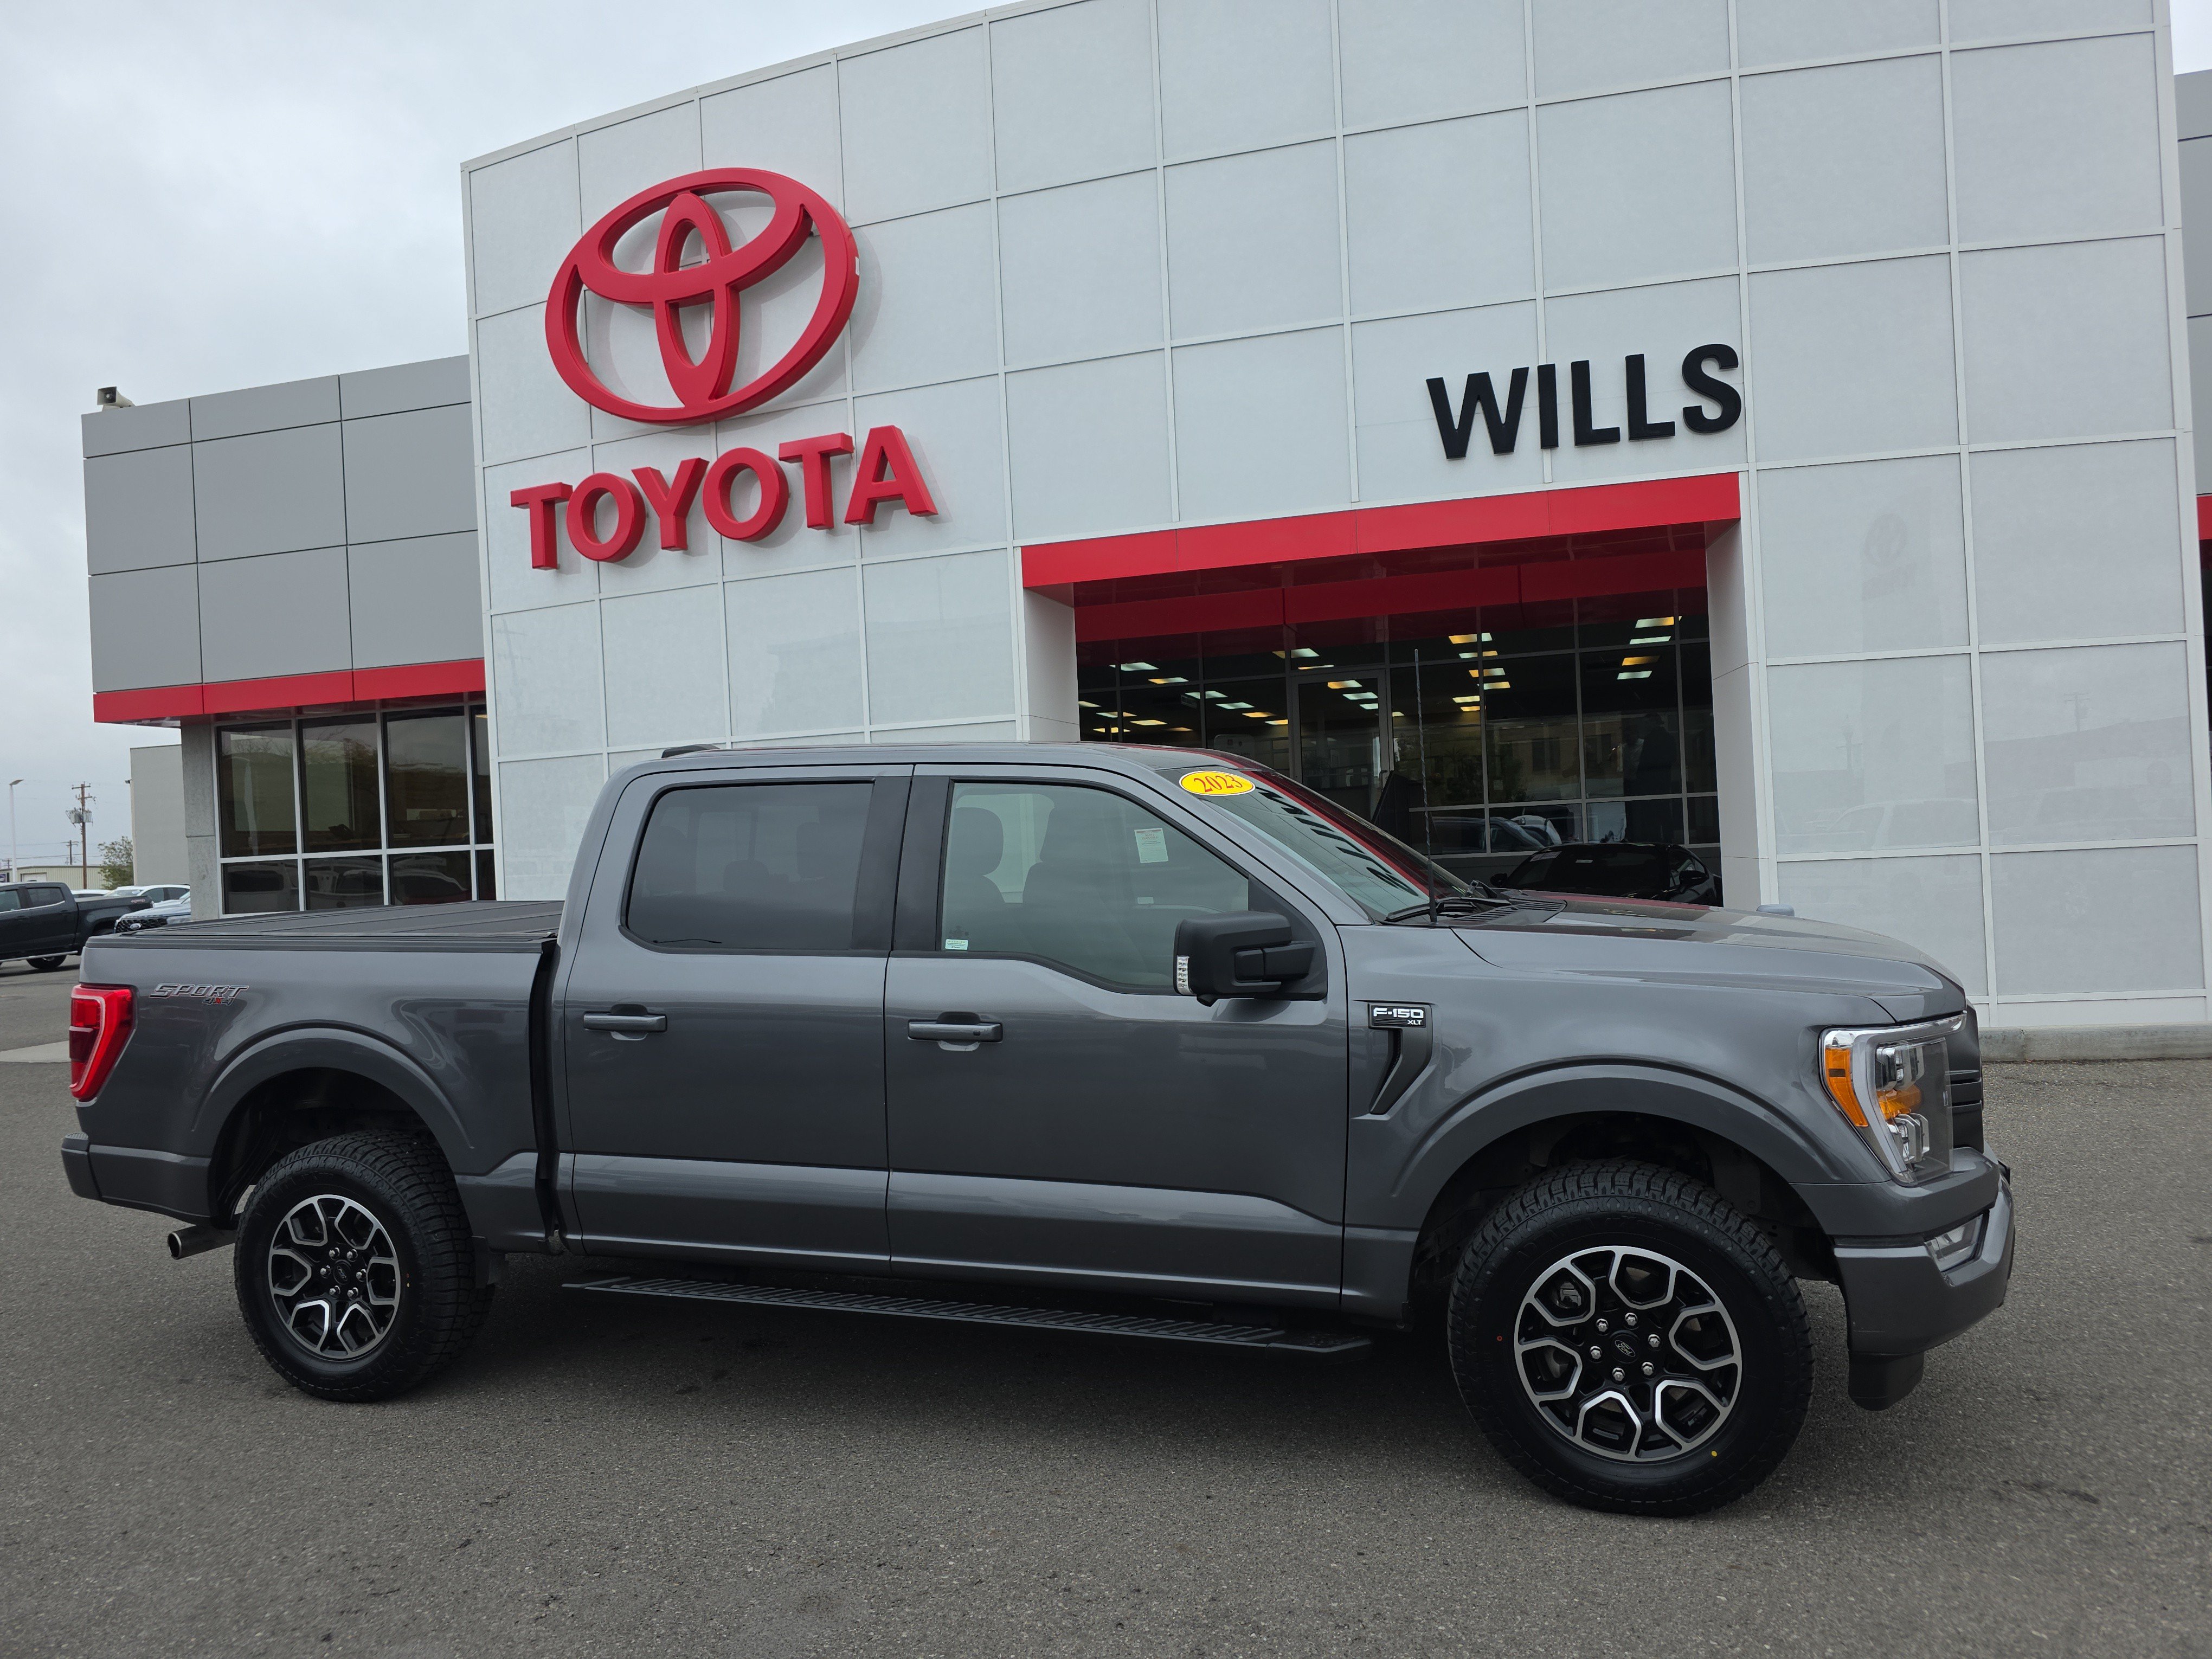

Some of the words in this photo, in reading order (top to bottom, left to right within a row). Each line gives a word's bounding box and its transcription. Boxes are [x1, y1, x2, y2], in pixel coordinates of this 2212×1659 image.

[1426, 344, 1742, 459] WILLS
[511, 425, 938, 570] TOYOTA
[1194, 775, 1243, 792] 2023
[149, 983, 249, 999] SPORT
[1373, 1007, 1424, 1019] F-150
